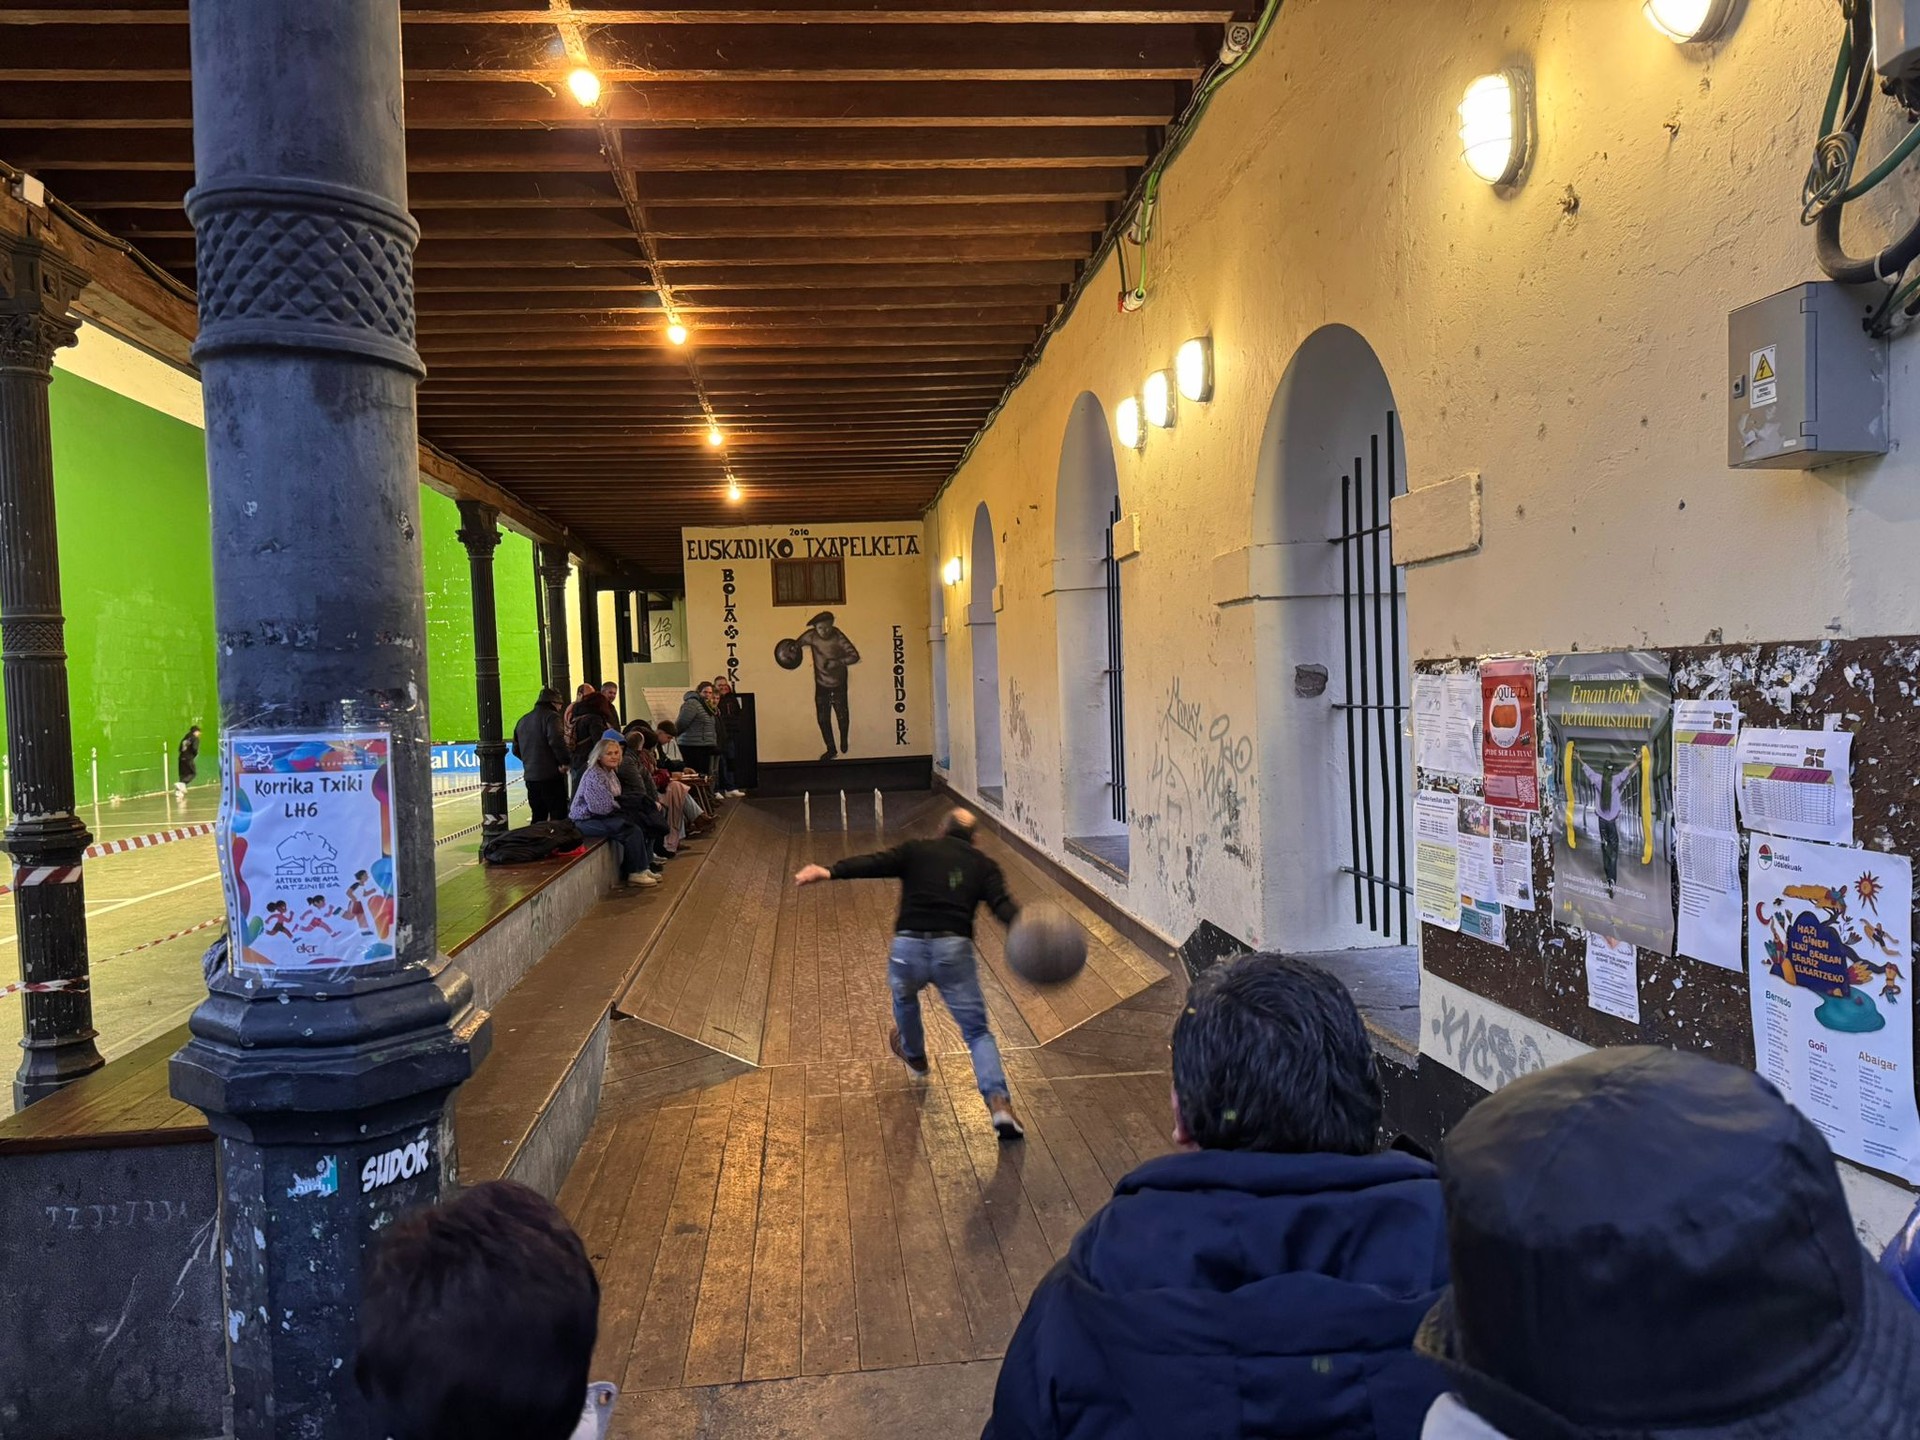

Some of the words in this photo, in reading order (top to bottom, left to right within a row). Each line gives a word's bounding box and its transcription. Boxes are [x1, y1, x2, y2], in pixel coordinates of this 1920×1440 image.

[789, 528, 809, 537] 2010
[687, 538, 794, 560] EUSKADIKO
[803, 535, 920, 558] TXAPELKETA
[721, 568, 738, 623] BOLA
[892, 625, 906, 713] ERRONDO
[1570, 685, 1605, 704] Eman
[1561, 705, 1651, 729] berdintasunari
[91, 747, 97, 758] 2
[431, 751, 448, 769] al
[255, 777, 313, 797] Korrika
[319, 774, 363, 793] Txiki
[285, 802, 318, 818] LH6
[1797, 924, 1817, 938] HAZI
[1794, 965, 1844, 983] ELKARTZEKO
[1808, 1039, 1827, 1053] Goñi
[1859, 1051, 1898, 1072] Abaigar
[361, 1138, 429, 1193] SUDOR
